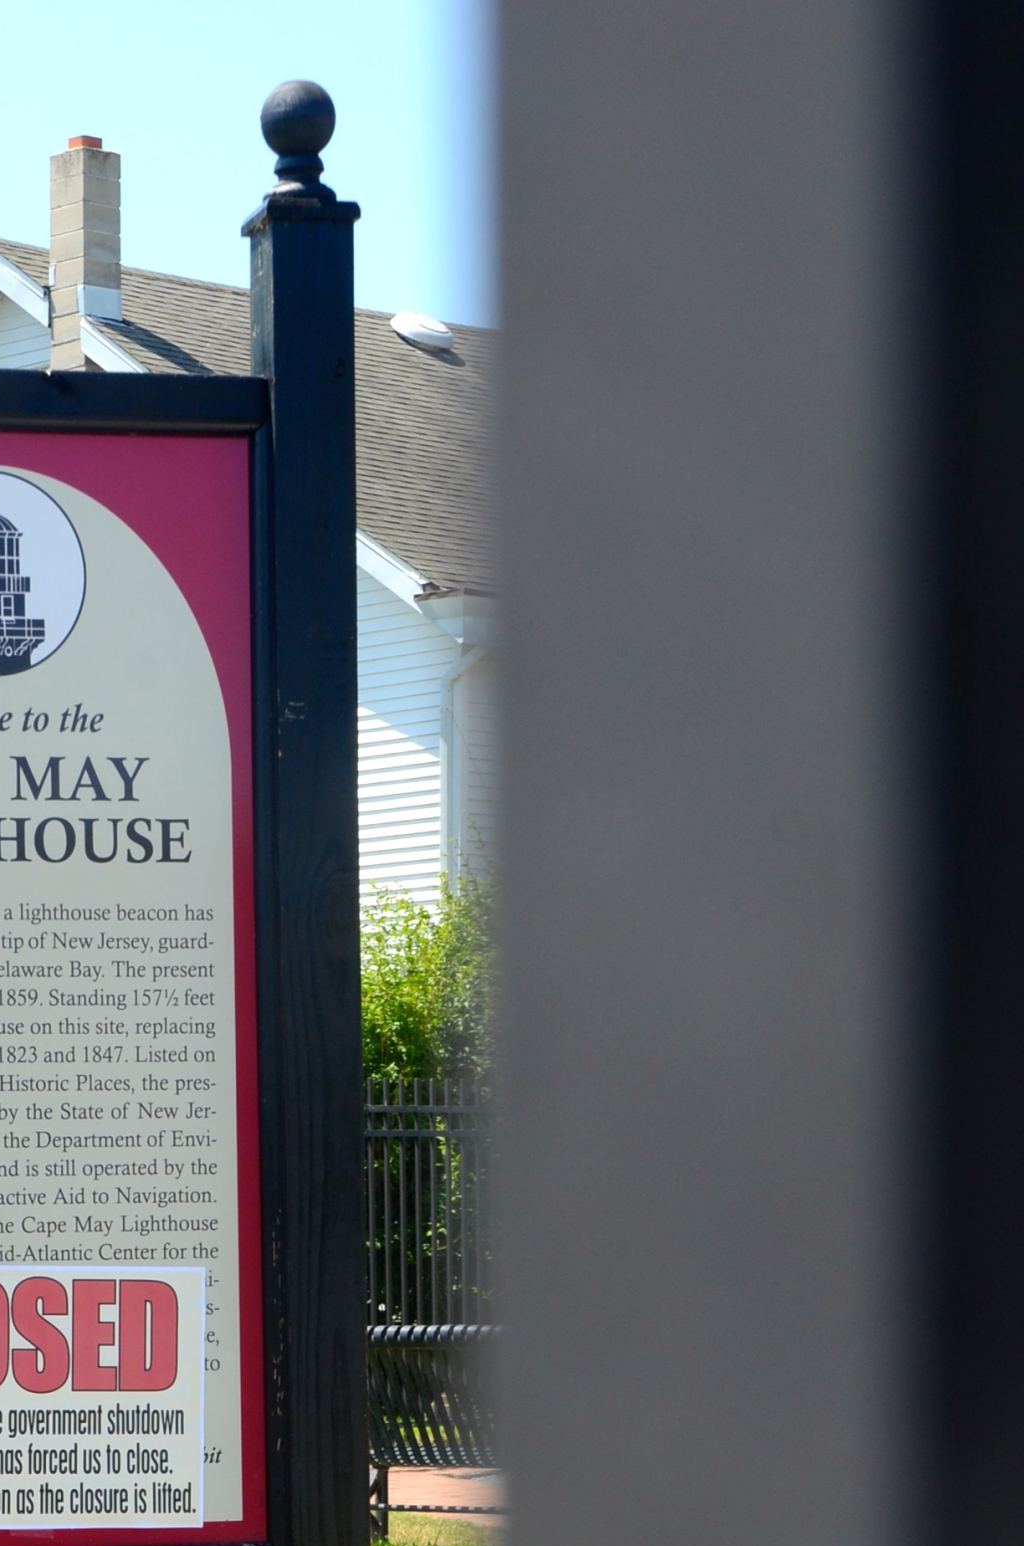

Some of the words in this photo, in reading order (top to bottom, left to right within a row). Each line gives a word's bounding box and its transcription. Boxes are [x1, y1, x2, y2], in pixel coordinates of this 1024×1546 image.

[21, 707, 50, 733] to
[59, 702, 105, 733] the
[9, 755, 150, 802] MAY
[3, 907, 14, 921] a
[19, 902, 111, 926] lighthouse
[116, 903, 179, 922] beacon
[184, 903, 214, 922] has
[0, 931, 25, 954] tip
[27, 930, 49, 950] of
[52, 931, 94, 950] New
[96, 931, 154, 954] Jersey,
[158, 931, 215, 954] guard-
[69, 960, 105, 983] Bay.
[111, 960, 147, 978] The
[151, 963, 216, 983] present
[48, 988, 128, 1011] Standing
[184, 987, 216, 1007] feet
[29, 1022, 53, 1035] on
[58, 1016, 90, 1035] this
[95, 1016, 129, 1038] site,
[135, 1016, 217, 1040] replacing
[43, 1045, 76, 1064] and
[84, 1045, 129, 1064] 1847.
[135, 1044, 189, 1063] Listed
[193, 1049, 216, 1063] on
[75, 1073, 135, 1095] Places,
[141, 1073, 169, 1092] the
[174, 1078, 217, 1096] pres-
[25, 1102, 54, 1121] the
[60, 1102, 104, 1121] State
[110, 1101, 131, 1120] of
[137, 1101, 179, 1120] New
[185, 1101, 217, 1120] Jer-
[3, 1131, 31, 1149] the
[35, 1130, 142, 1153] Department
[146, 1129, 167, 1148] of
[171, 1128, 217, 1148] Envi-
[25, 1159, 40, 1177] is
[44, 1158, 76, 1177] still
[82, 1158, 159, 1181] operated
[163, 1157, 185, 1180] by
[190, 1157, 218, 1176] the
[52, 1186, 86, 1205] Aid
[91, 1189, 110, 1205] to
[115, 1185, 217, 1209] Navigation.
[21, 1215, 67, 1238] Cape
[73, 1215, 114, 1237] May
[120, 1214, 219, 1237] Lighthouse
[98, 1243, 158, 1261] Center
[162, 1241, 188, 1260] for
[191, 1241, 220, 1260] the
[7, 1404, 103, 1439] government
[106, 1402, 185, 1435] shutdown
[27, 1442, 78, 1475] forced
[82, 1448, 102, 1475] us
[105, 1443, 122, 1475] to
[126, 1442, 174, 1475] close.
[16, 1488, 35, 1515] as
[39, 1481, 65, 1515] the
[69, 1481, 129, 1515] closure
[133, 1482, 148, 1514] is
[152, 1481, 197, 1514] lifted.
